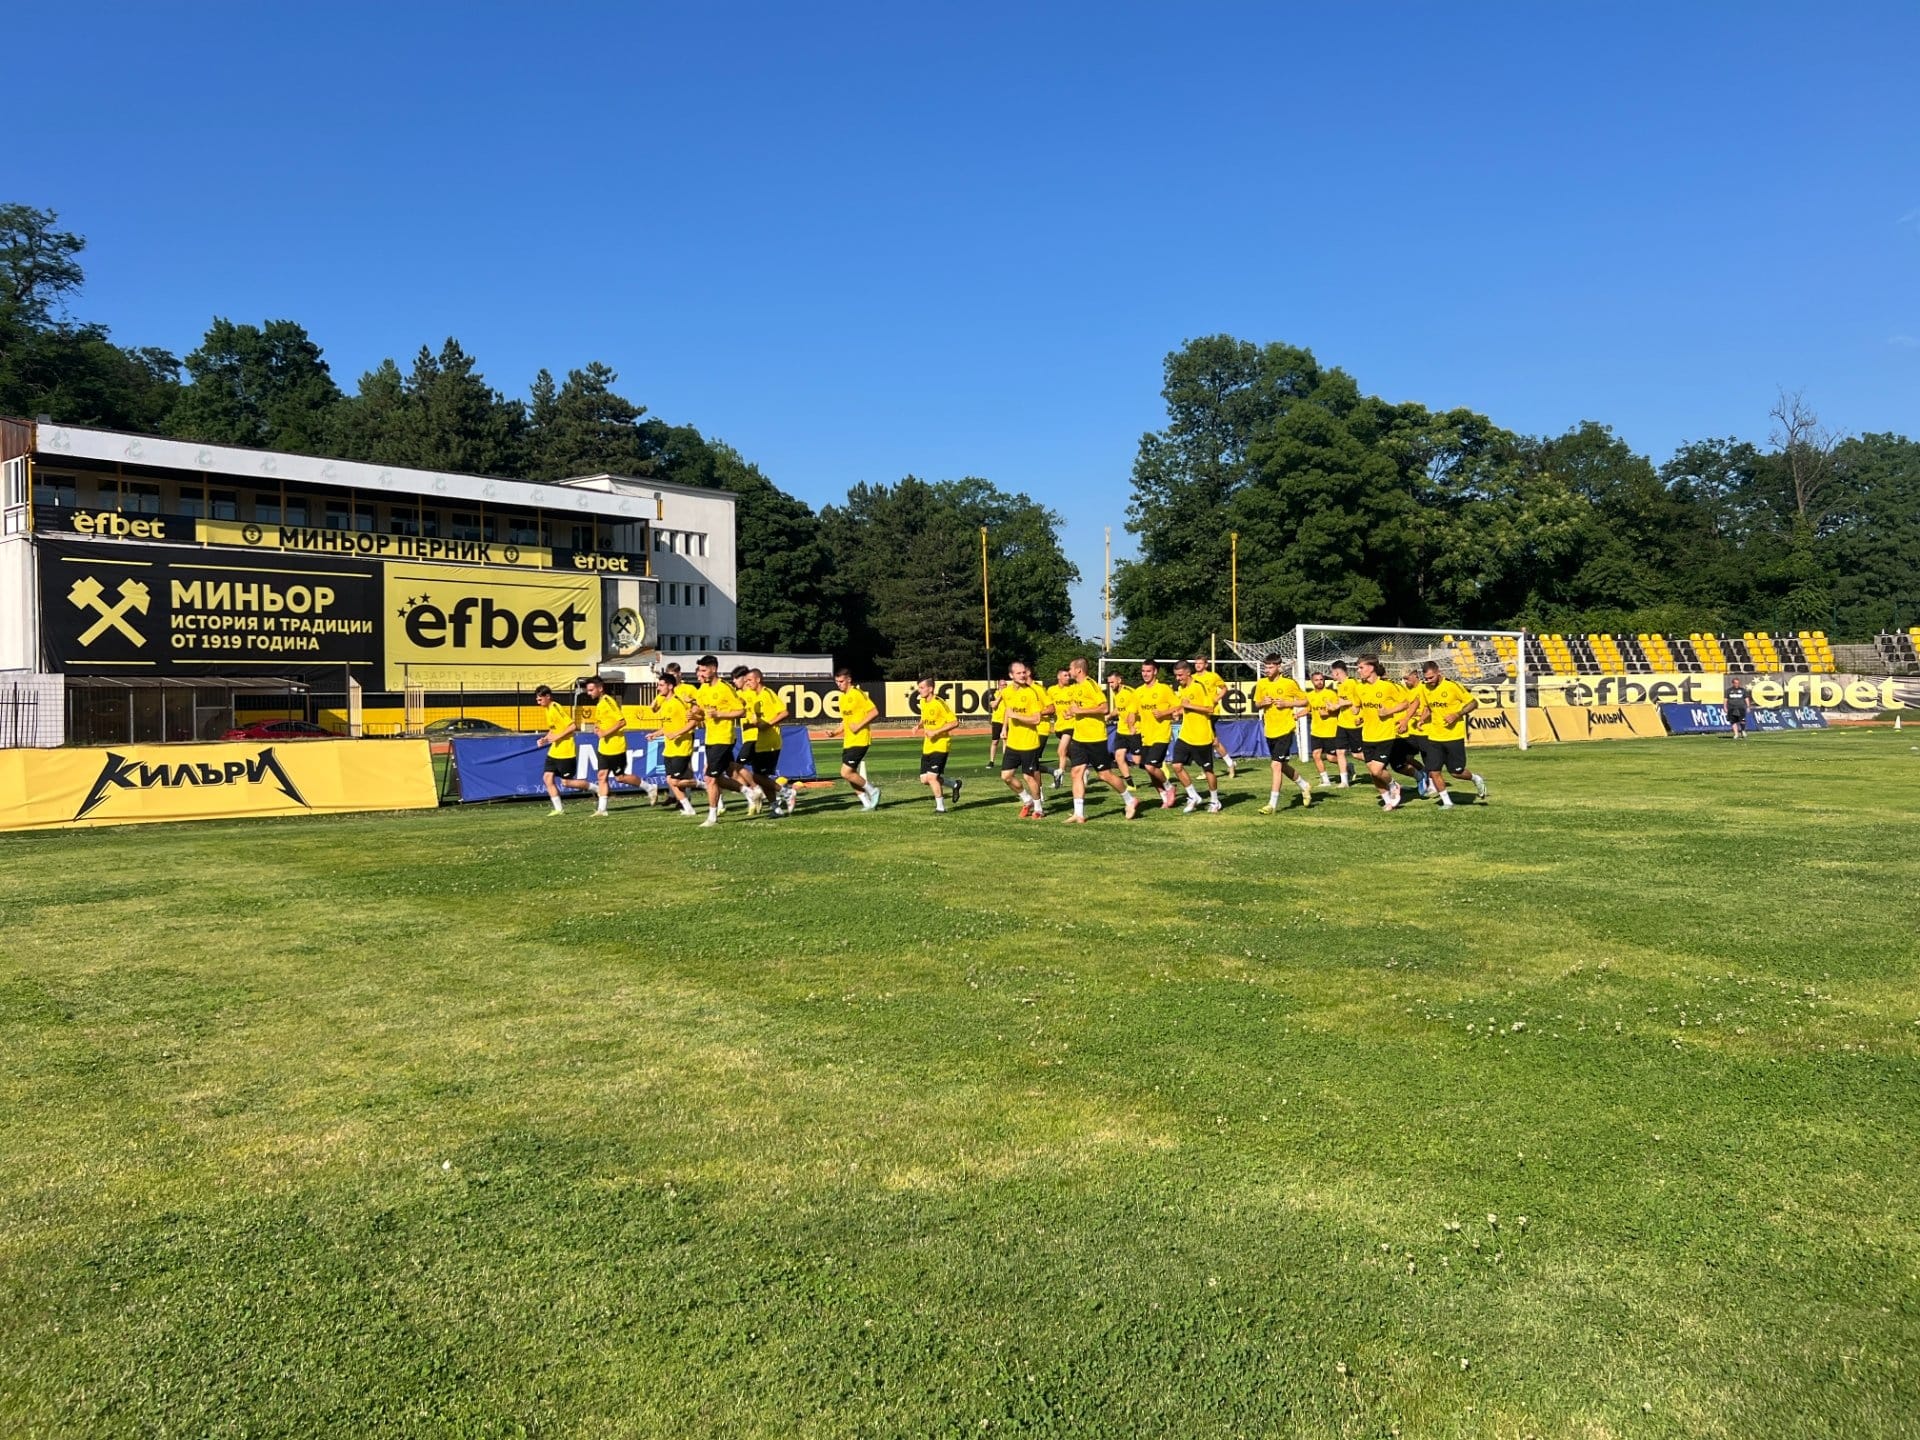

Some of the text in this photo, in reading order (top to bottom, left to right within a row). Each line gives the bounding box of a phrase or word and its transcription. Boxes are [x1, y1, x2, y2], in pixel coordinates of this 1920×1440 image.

[73, 511, 165, 538] efbet
[279, 526, 491, 561] МИНЬОР ПЕРНИК
[574, 552, 629, 572] efbet
[170, 580, 335, 613] МИНЬОР
[171, 614, 373, 634] ИСТОРИЯ И ТРАДИЦИИ
[405, 597, 587, 650] efbet
[171, 634, 320, 651] ОТ 1919 ГОДИНА
[1565, 676, 1702, 706] efbet
[1751, 675, 1905, 710] efbet
